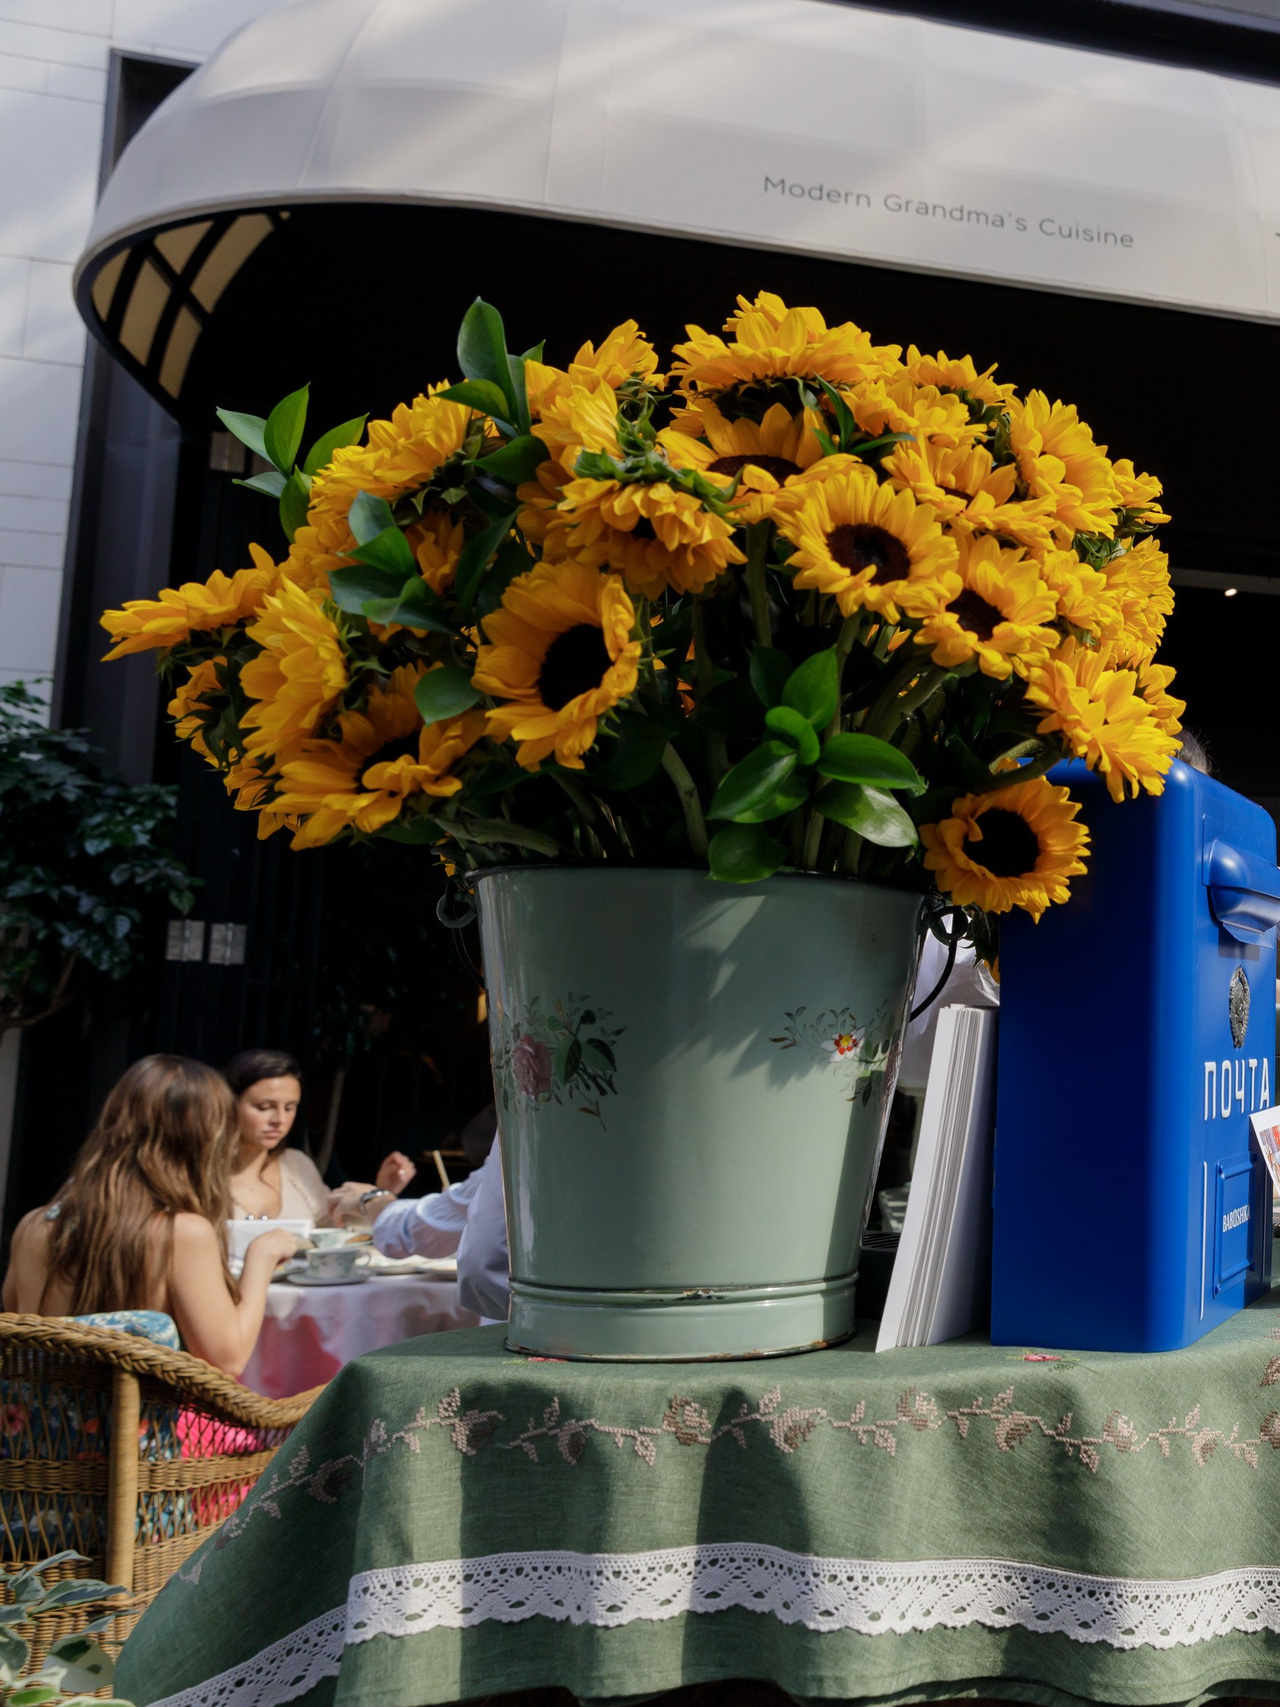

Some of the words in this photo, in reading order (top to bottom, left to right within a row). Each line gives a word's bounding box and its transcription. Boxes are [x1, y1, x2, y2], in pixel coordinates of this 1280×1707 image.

[763, 175, 872, 208] Modern
[883, 193, 1028, 232] Grandma's
[1039, 217, 1134, 248] Cuisine
[1203, 1057, 1270, 1121] ПОЧТА
